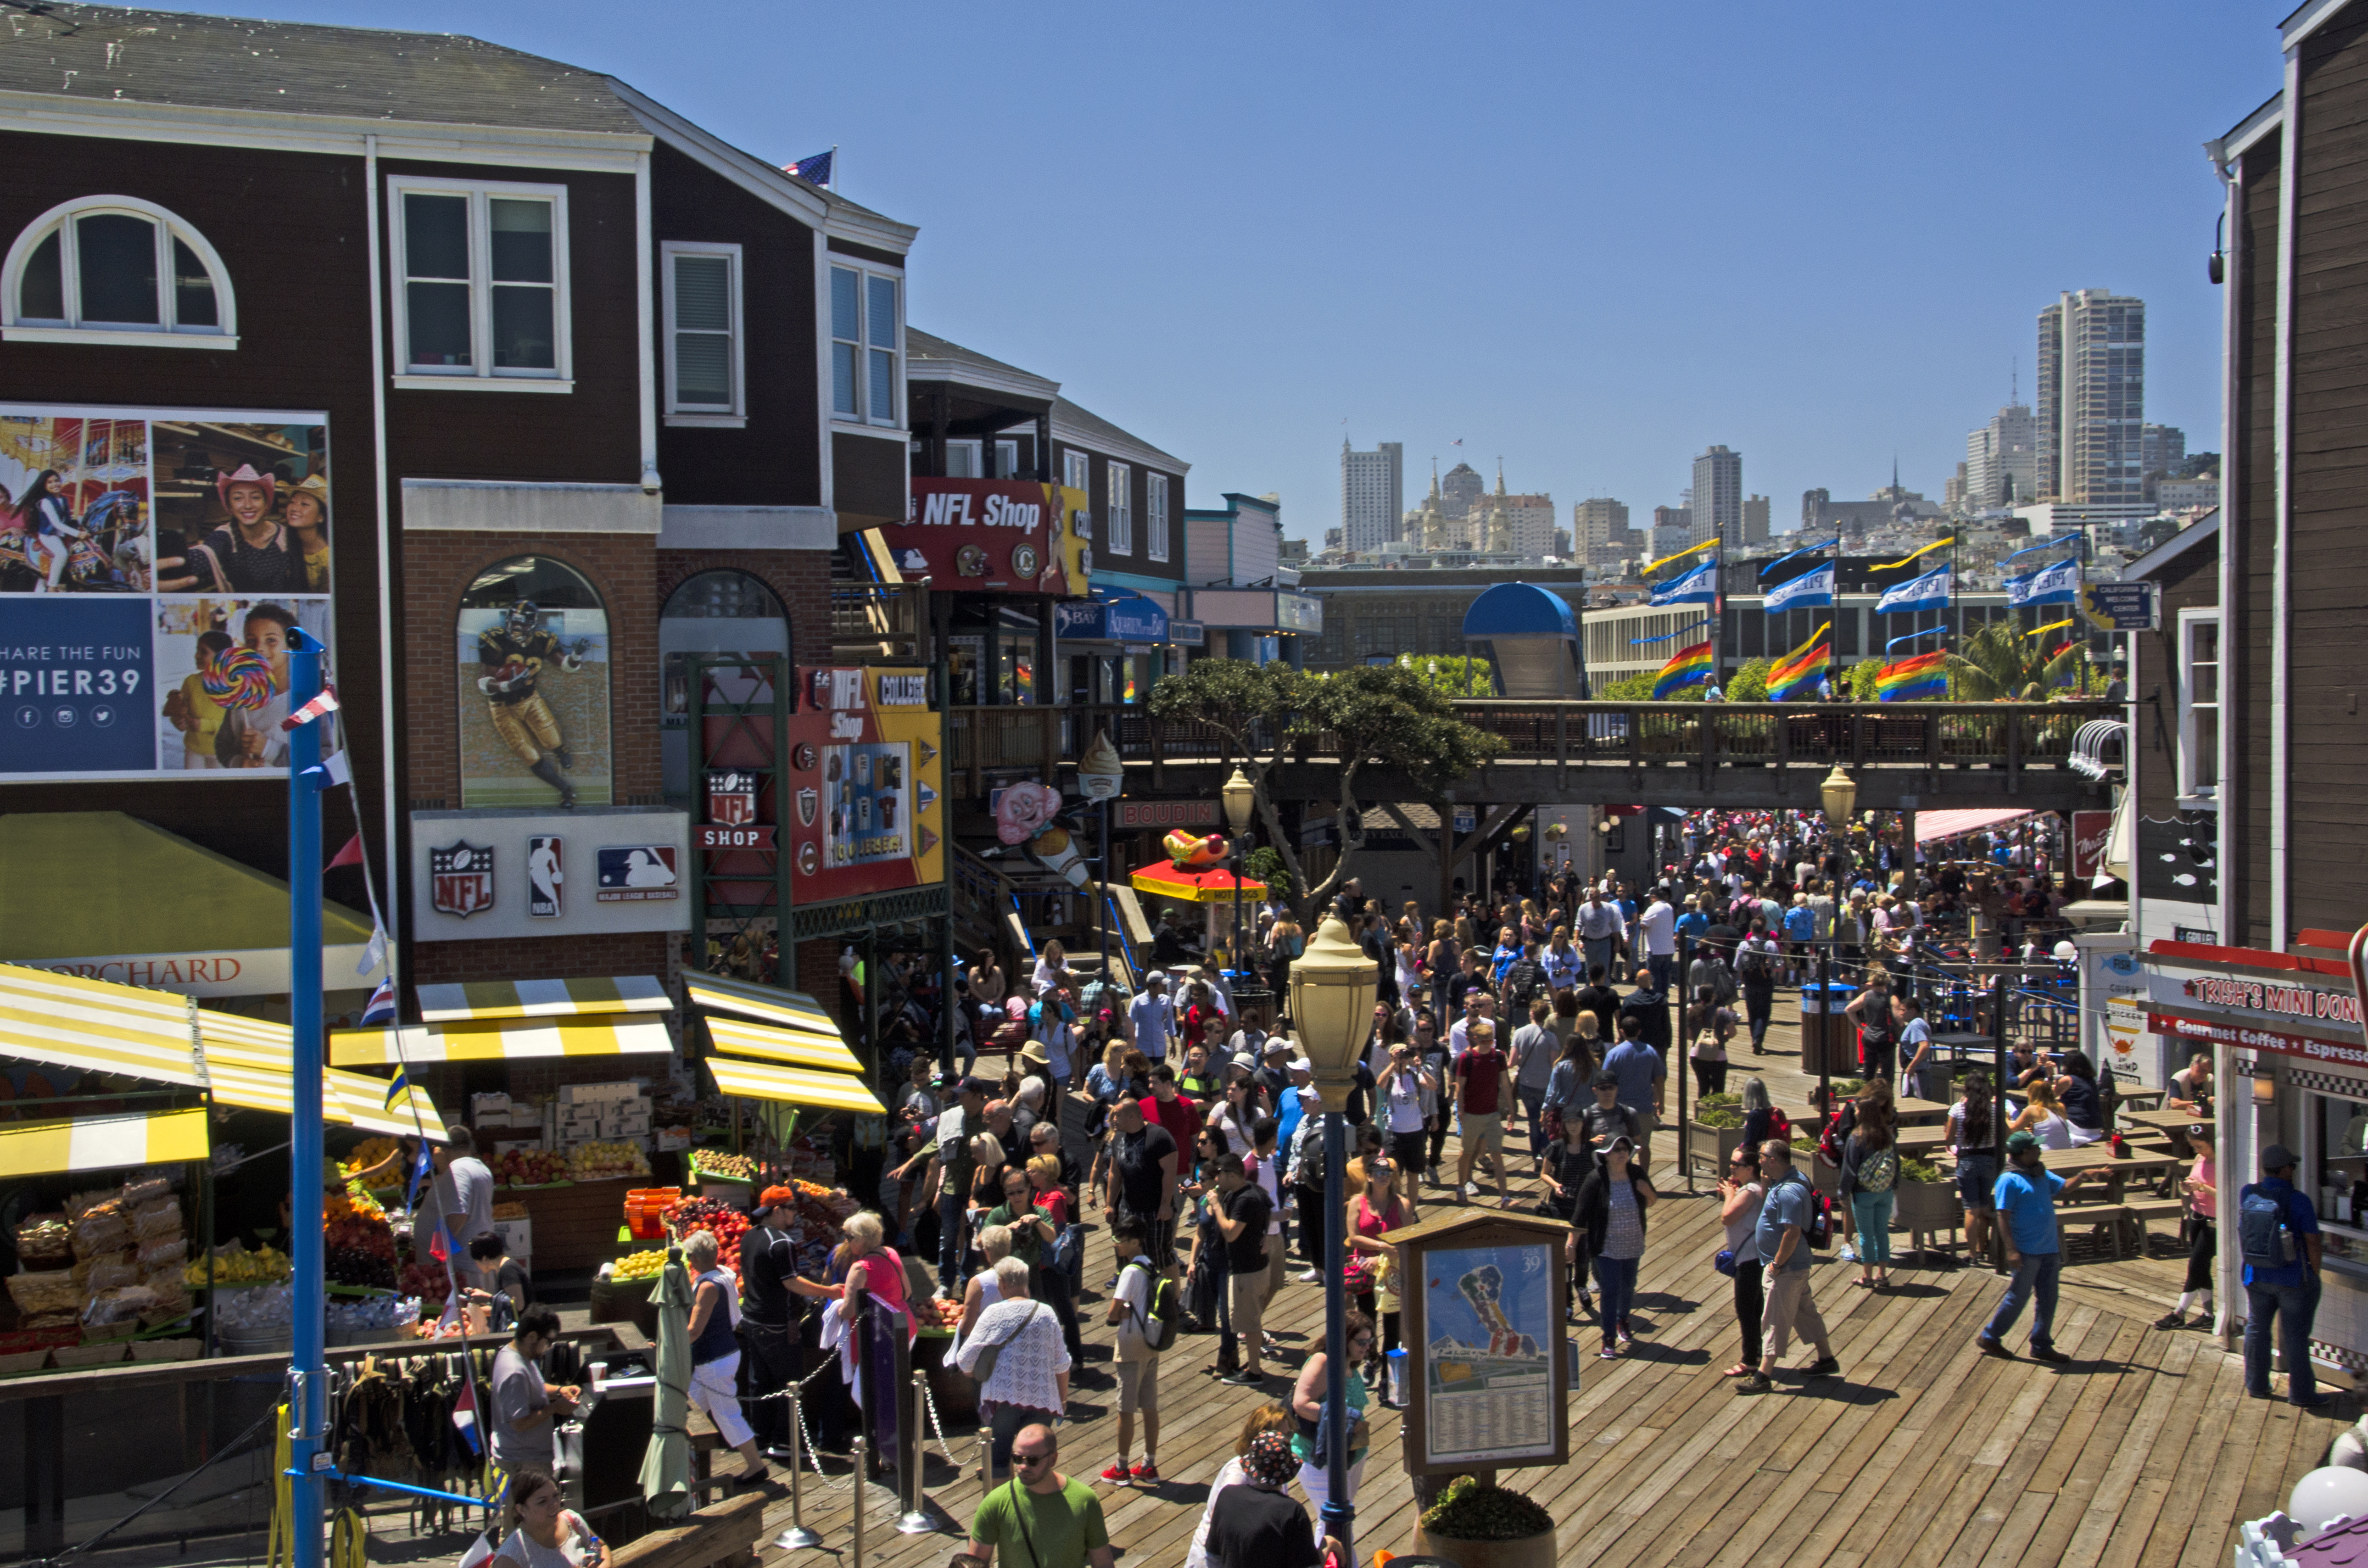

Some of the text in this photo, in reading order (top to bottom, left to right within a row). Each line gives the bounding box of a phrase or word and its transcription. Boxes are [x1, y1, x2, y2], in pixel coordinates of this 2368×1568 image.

[923, 493, 1040, 535] NFL Shop
[1072, 612, 1097, 624] BAY
[0, 647, 141, 660] HARE THE FUN
[0, 669, 140, 695] #PIER39
[829, 670, 865, 709] NFL
[830, 712, 864, 743] Shop
[711, 794, 753, 824] NFL
[1123, 803, 1212, 825] BOUDIN
[705, 831, 759, 846] SHOP
[437, 875, 491, 911] NFL
[1214, 889, 1258, 900] HOT OGS
[531, 902, 553, 914] NBA
[2113, 958, 2131, 971] FISH
[2195, 977, 2263, 1009] TRISH'S
[2265, 985, 2314, 1017] MINI
[2175, 1019, 2286, 1049] Gourmet Coffee
[1522, 1256, 1541, 1272] 39
